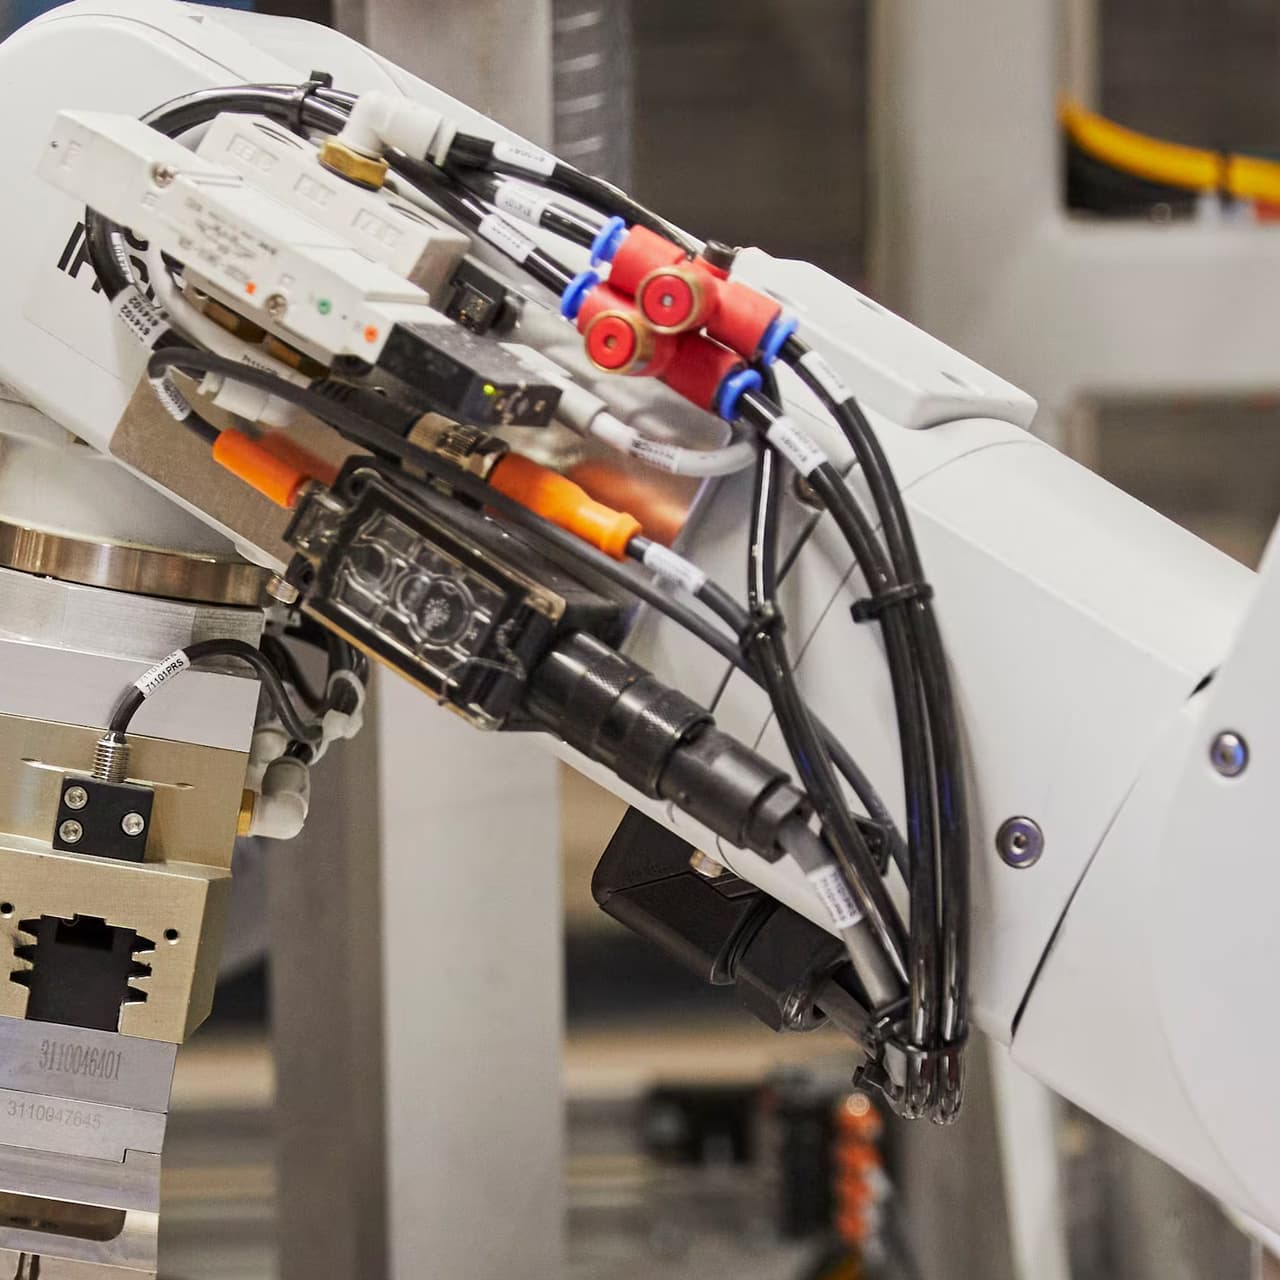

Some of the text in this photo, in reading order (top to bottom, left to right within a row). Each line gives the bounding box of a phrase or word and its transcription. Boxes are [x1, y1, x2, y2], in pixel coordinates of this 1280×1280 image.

[145, 658, 184, 692] 71101PRS
[39, 1039, 122, 1080] 3110046401
[7, 1101, 102, 1129] 3110047645
